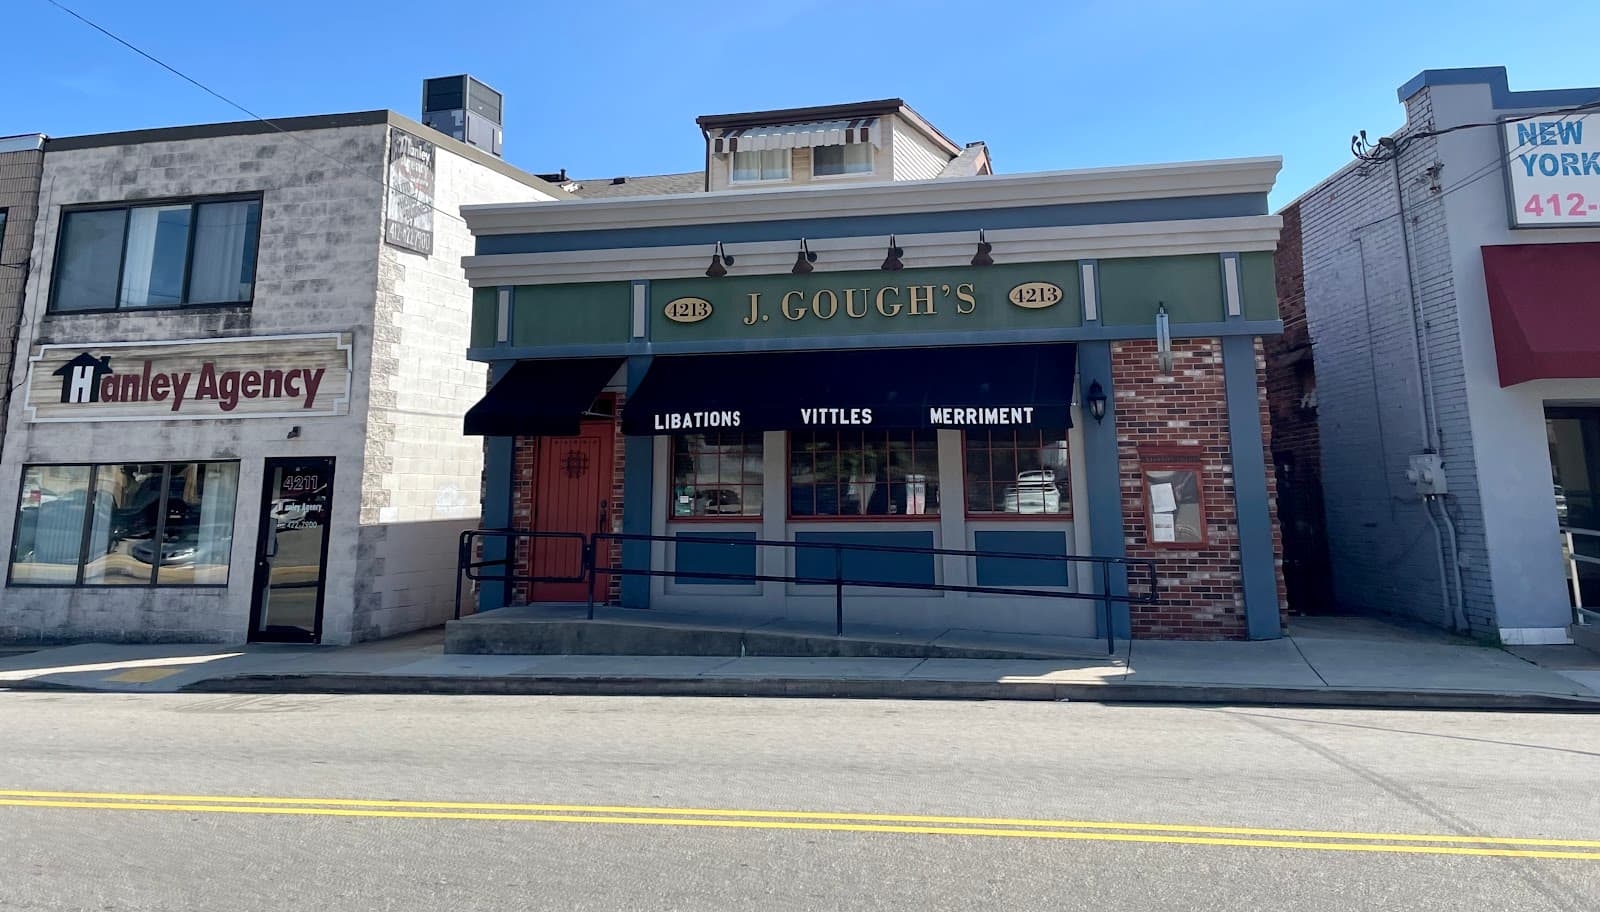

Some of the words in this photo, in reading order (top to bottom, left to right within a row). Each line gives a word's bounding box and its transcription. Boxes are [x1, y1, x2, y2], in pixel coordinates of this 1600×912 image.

[1517, 121, 1583, 145] NEW
[1519, 151, 1600, 177] YORK
[1524, 193, 1600, 217] 412-
[743, 292, 769, 325] J.
[781, 283, 977, 321] GOUGH'S
[1013, 286, 1059, 303] 4213
[668, 302, 708, 318] 4213
[69, 360, 192, 411] Hanley
[195, 361, 325, 411] Agency
[654, 410, 741, 430] LIBATIONS
[800, 408, 873, 425] VITTLES
[929, 407, 1034, 425] MERRIMENT
[283, 475, 318, 491] 4211
